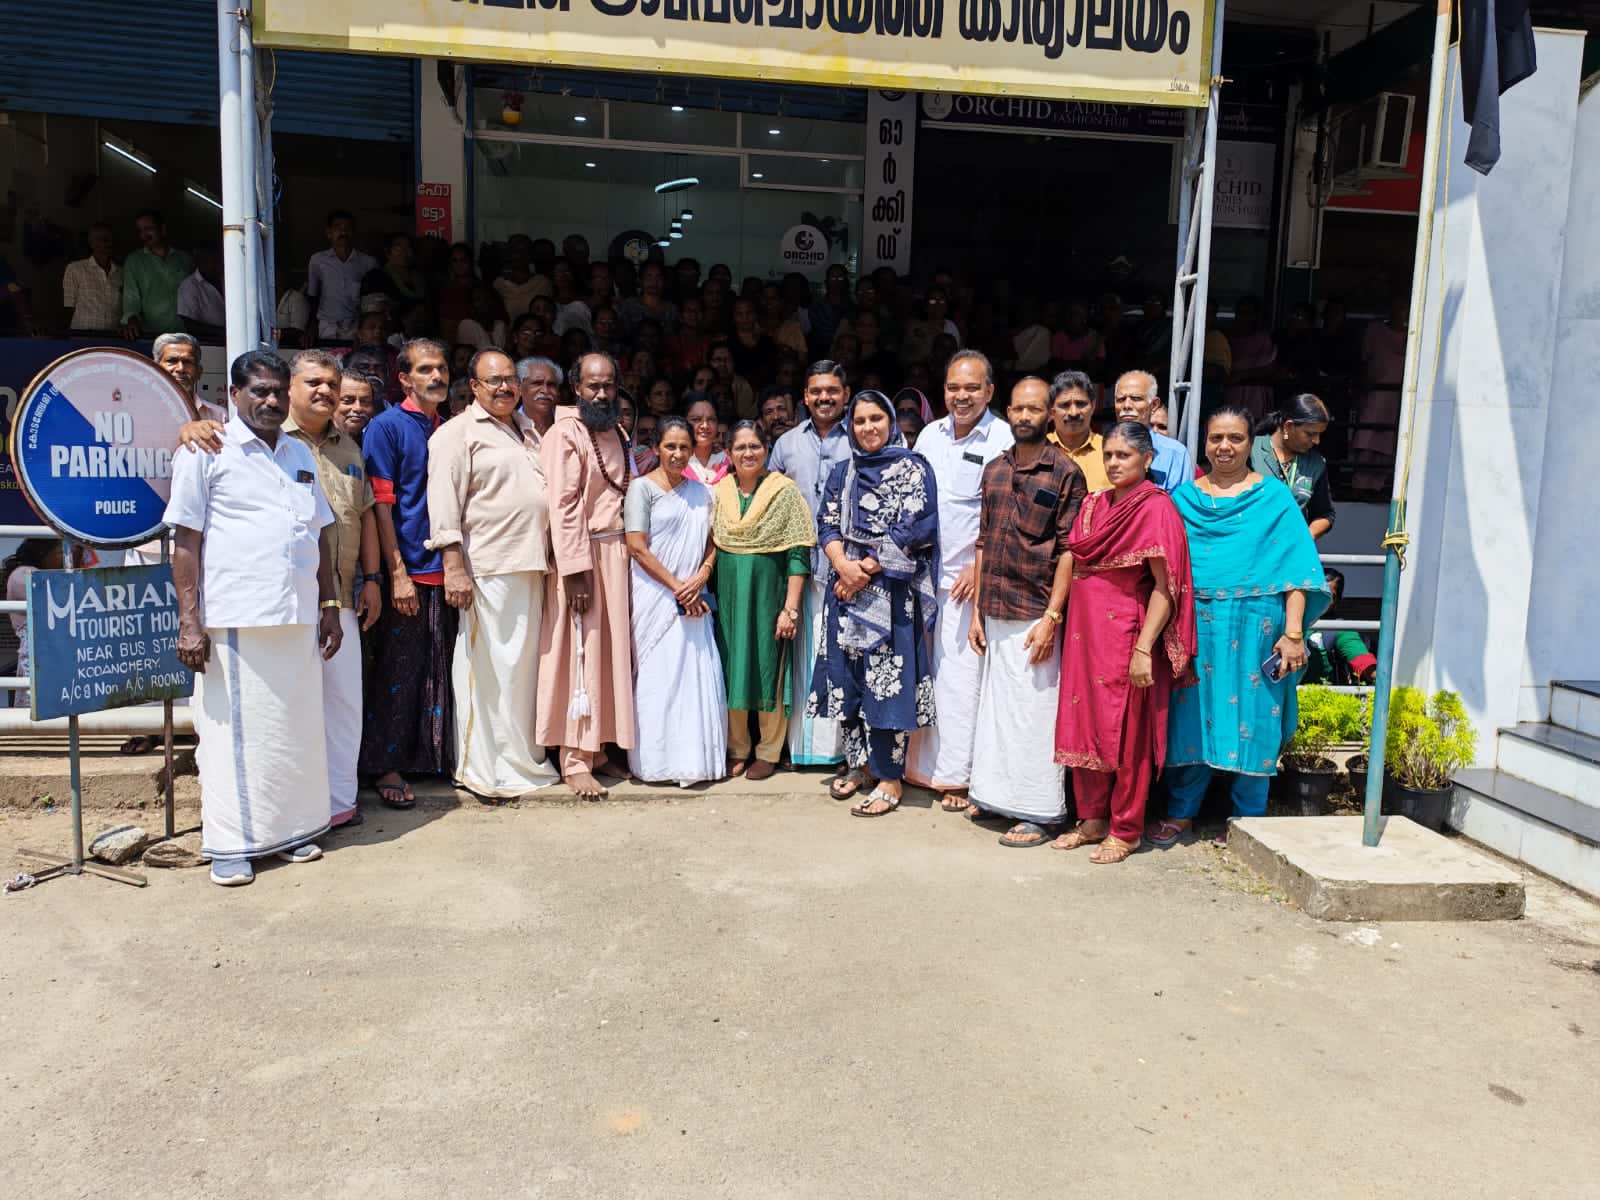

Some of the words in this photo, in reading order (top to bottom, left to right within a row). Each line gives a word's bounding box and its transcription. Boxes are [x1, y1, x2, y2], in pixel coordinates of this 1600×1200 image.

[955, 94, 1051, 120] ORCHID
[783, 250, 825, 261] ORCHID
[94, 411, 134, 445] NO
[50, 445, 173, 478] PARKING
[95, 500, 137, 515] POLICE
[77, 614, 144, 640] TOURIST
[151, 611, 181, 633] HOM
[77, 644, 113, 663] NEAR
[120, 641, 145, 657] BUS
[152, 636, 179, 654] STA
[61, 678, 82, 704] A/C
[95, 681, 119, 697] Non
[126, 671, 144, 693] A/C
